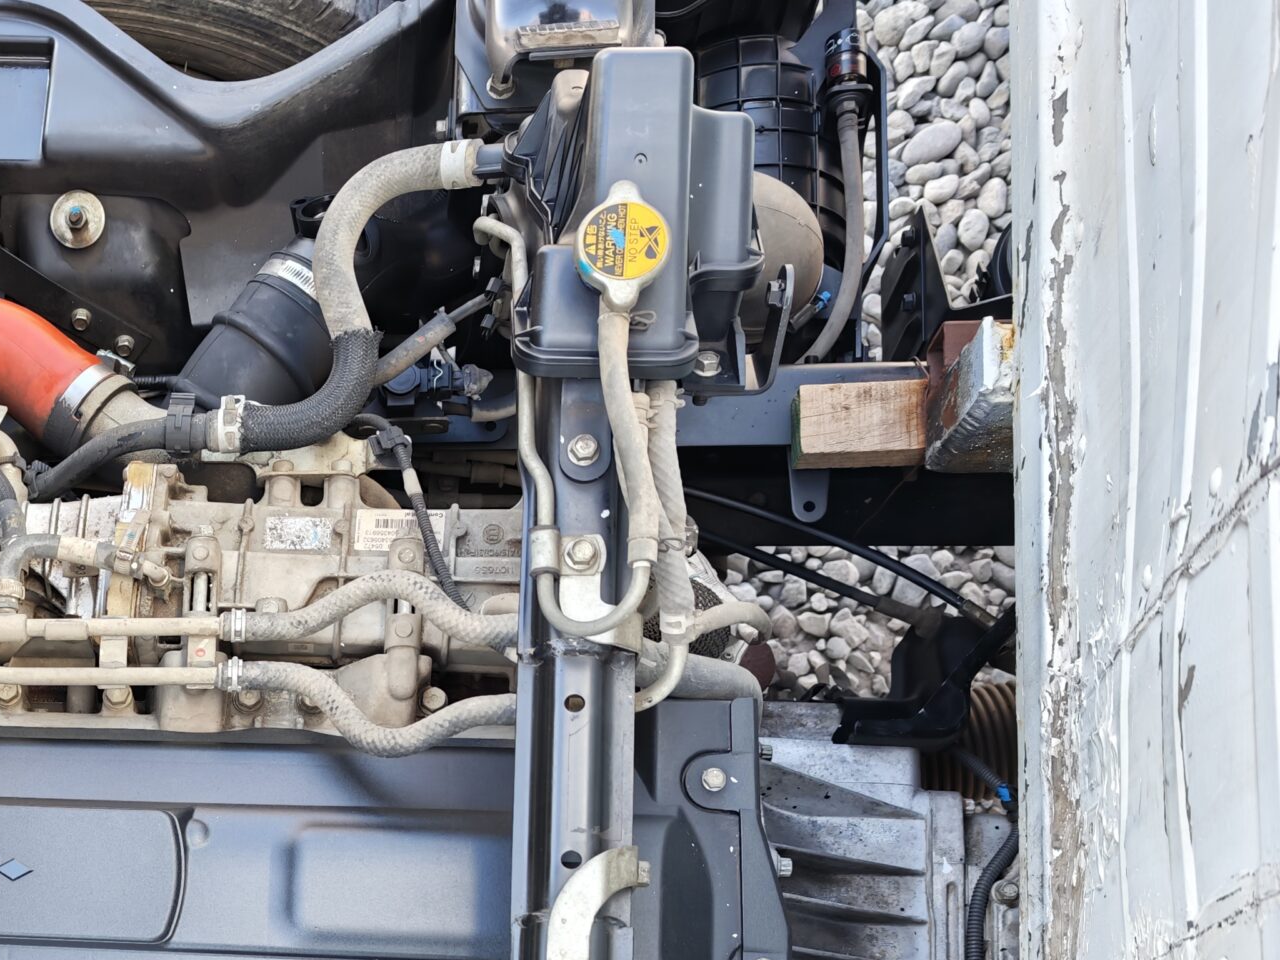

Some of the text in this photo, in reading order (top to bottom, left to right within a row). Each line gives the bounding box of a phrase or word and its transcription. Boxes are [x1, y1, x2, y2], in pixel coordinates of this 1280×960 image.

[618, 205, 627, 218] HOT
[605, 213, 617, 267] WARNG
[629, 218, 640, 262] NO STEP
